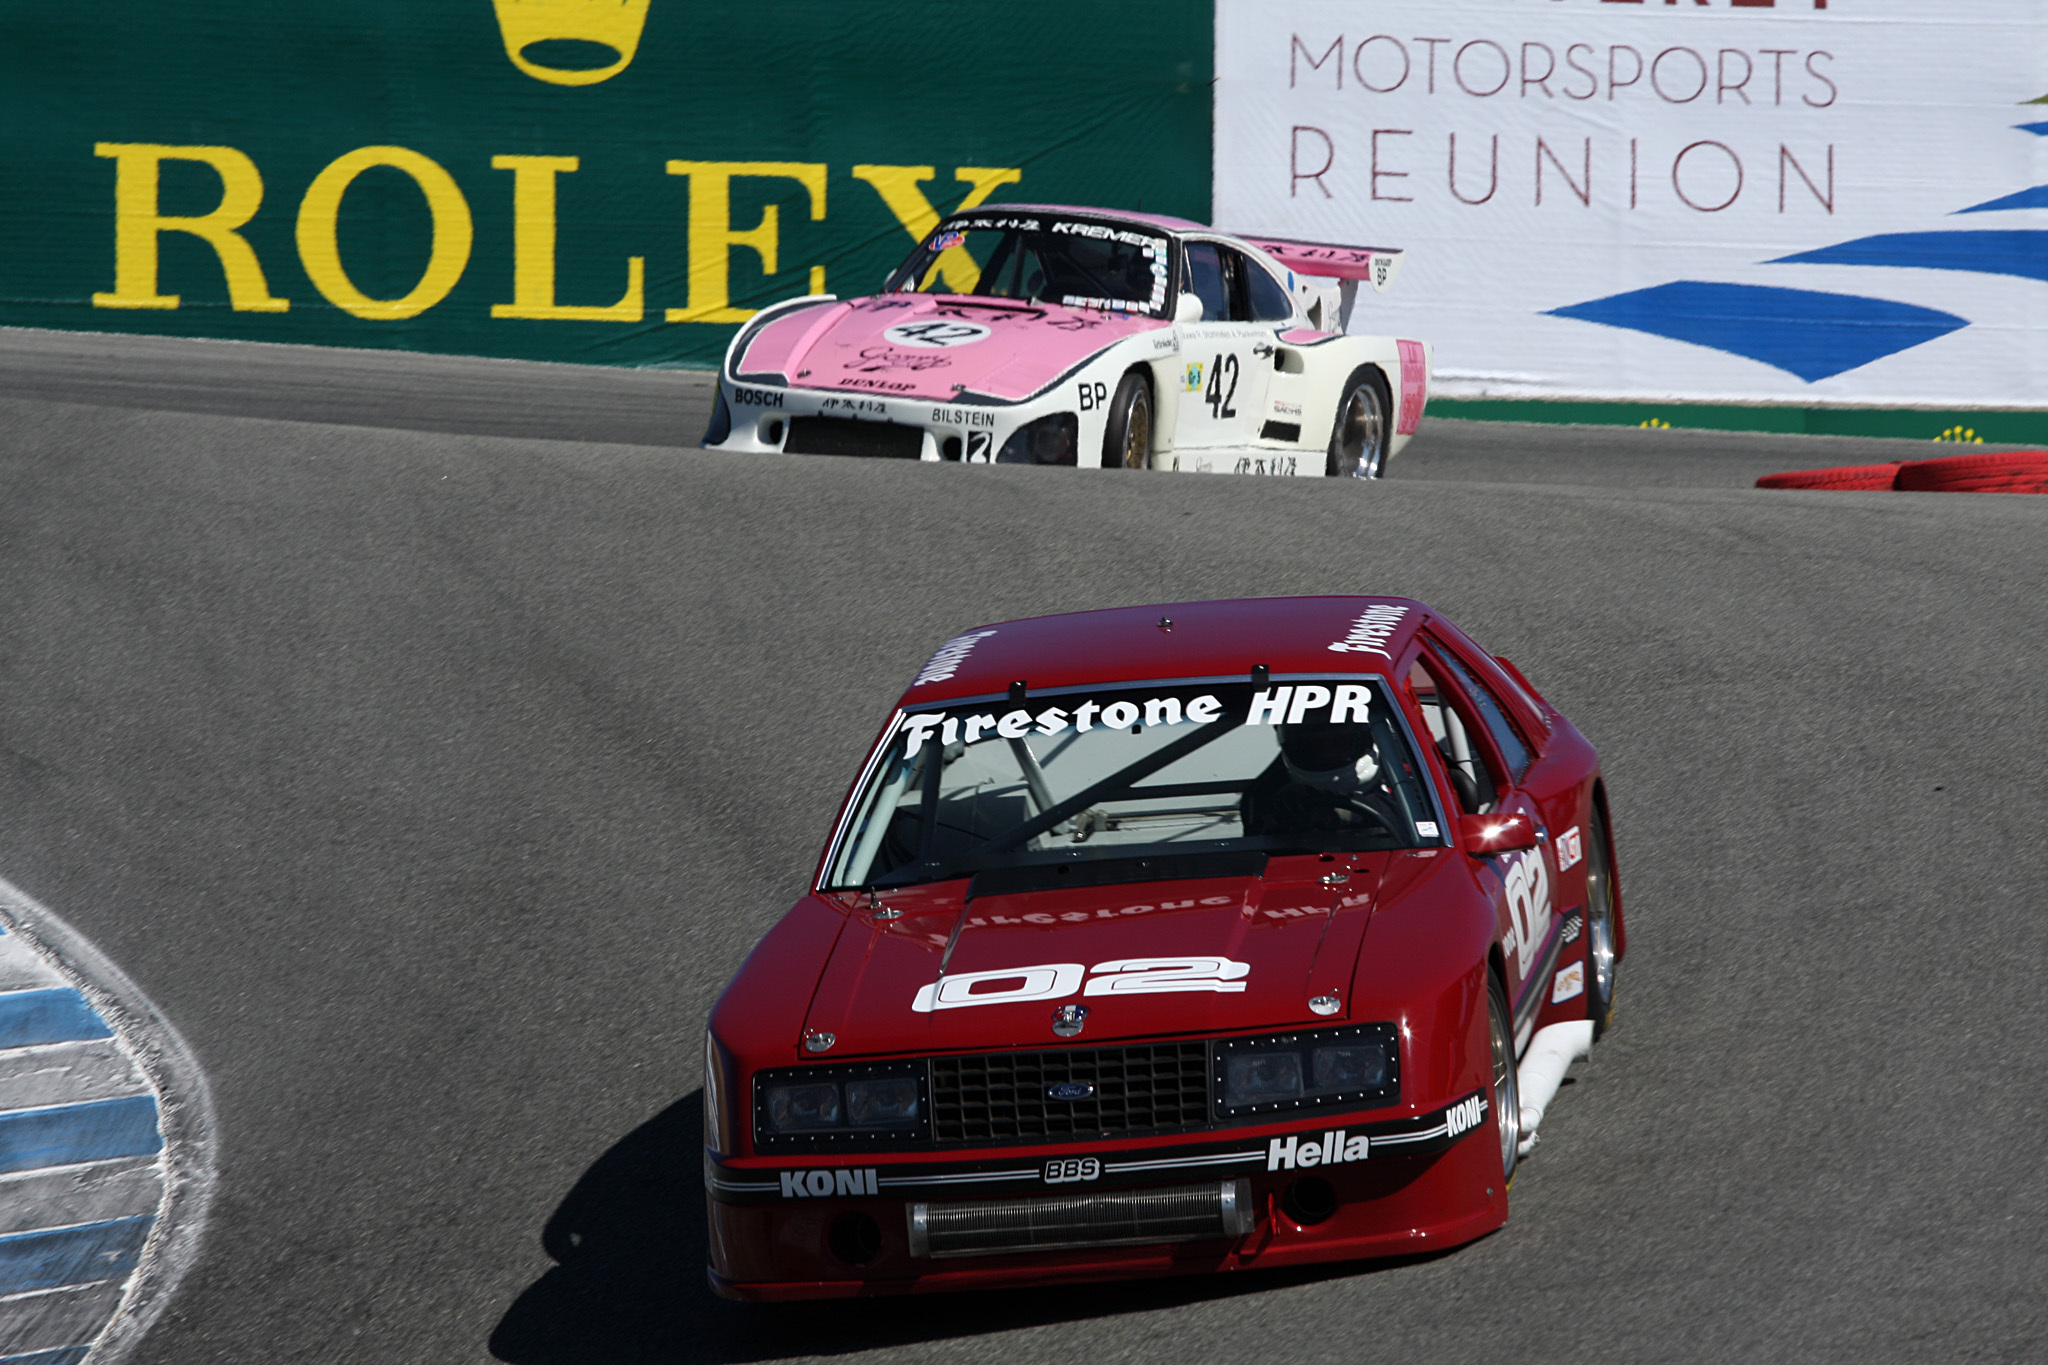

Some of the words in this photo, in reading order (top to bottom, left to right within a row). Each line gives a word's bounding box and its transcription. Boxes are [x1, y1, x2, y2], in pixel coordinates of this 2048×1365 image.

[1290, 34, 1837, 108] MOTORSPORTS
[1290, 125, 1835, 214] REUNION
[92, 142, 1021, 323] ROLEX
[1052, 222, 1156, 249] KREMER
[1377, 267, 1387, 286] BP
[895, 323, 983, 346] 42
[735, 387, 784, 408] BOSCH
[838, 378, 917, 391] DUNLOP
[1078, 382, 1107, 411] BP
[1205, 353, 1240, 419] 42
[932, 408, 994, 427] BILSTEIN
[1327, 604, 1410, 660] Firestone
[902, 694, 1223, 760] Firestone
[1245, 685, 1372, 726] HPR
[1505, 844, 1552, 981] 02
[912, 956, 1251, 1013] 02
[1058, 1086, 1082, 1096] Ford
[1446, 1095, 1482, 1138] KONI
[1267, 1130, 1369, 1172] Hella
[780, 1168, 879, 1198] KONI
[1045, 1157, 1100, 1184] BBS
